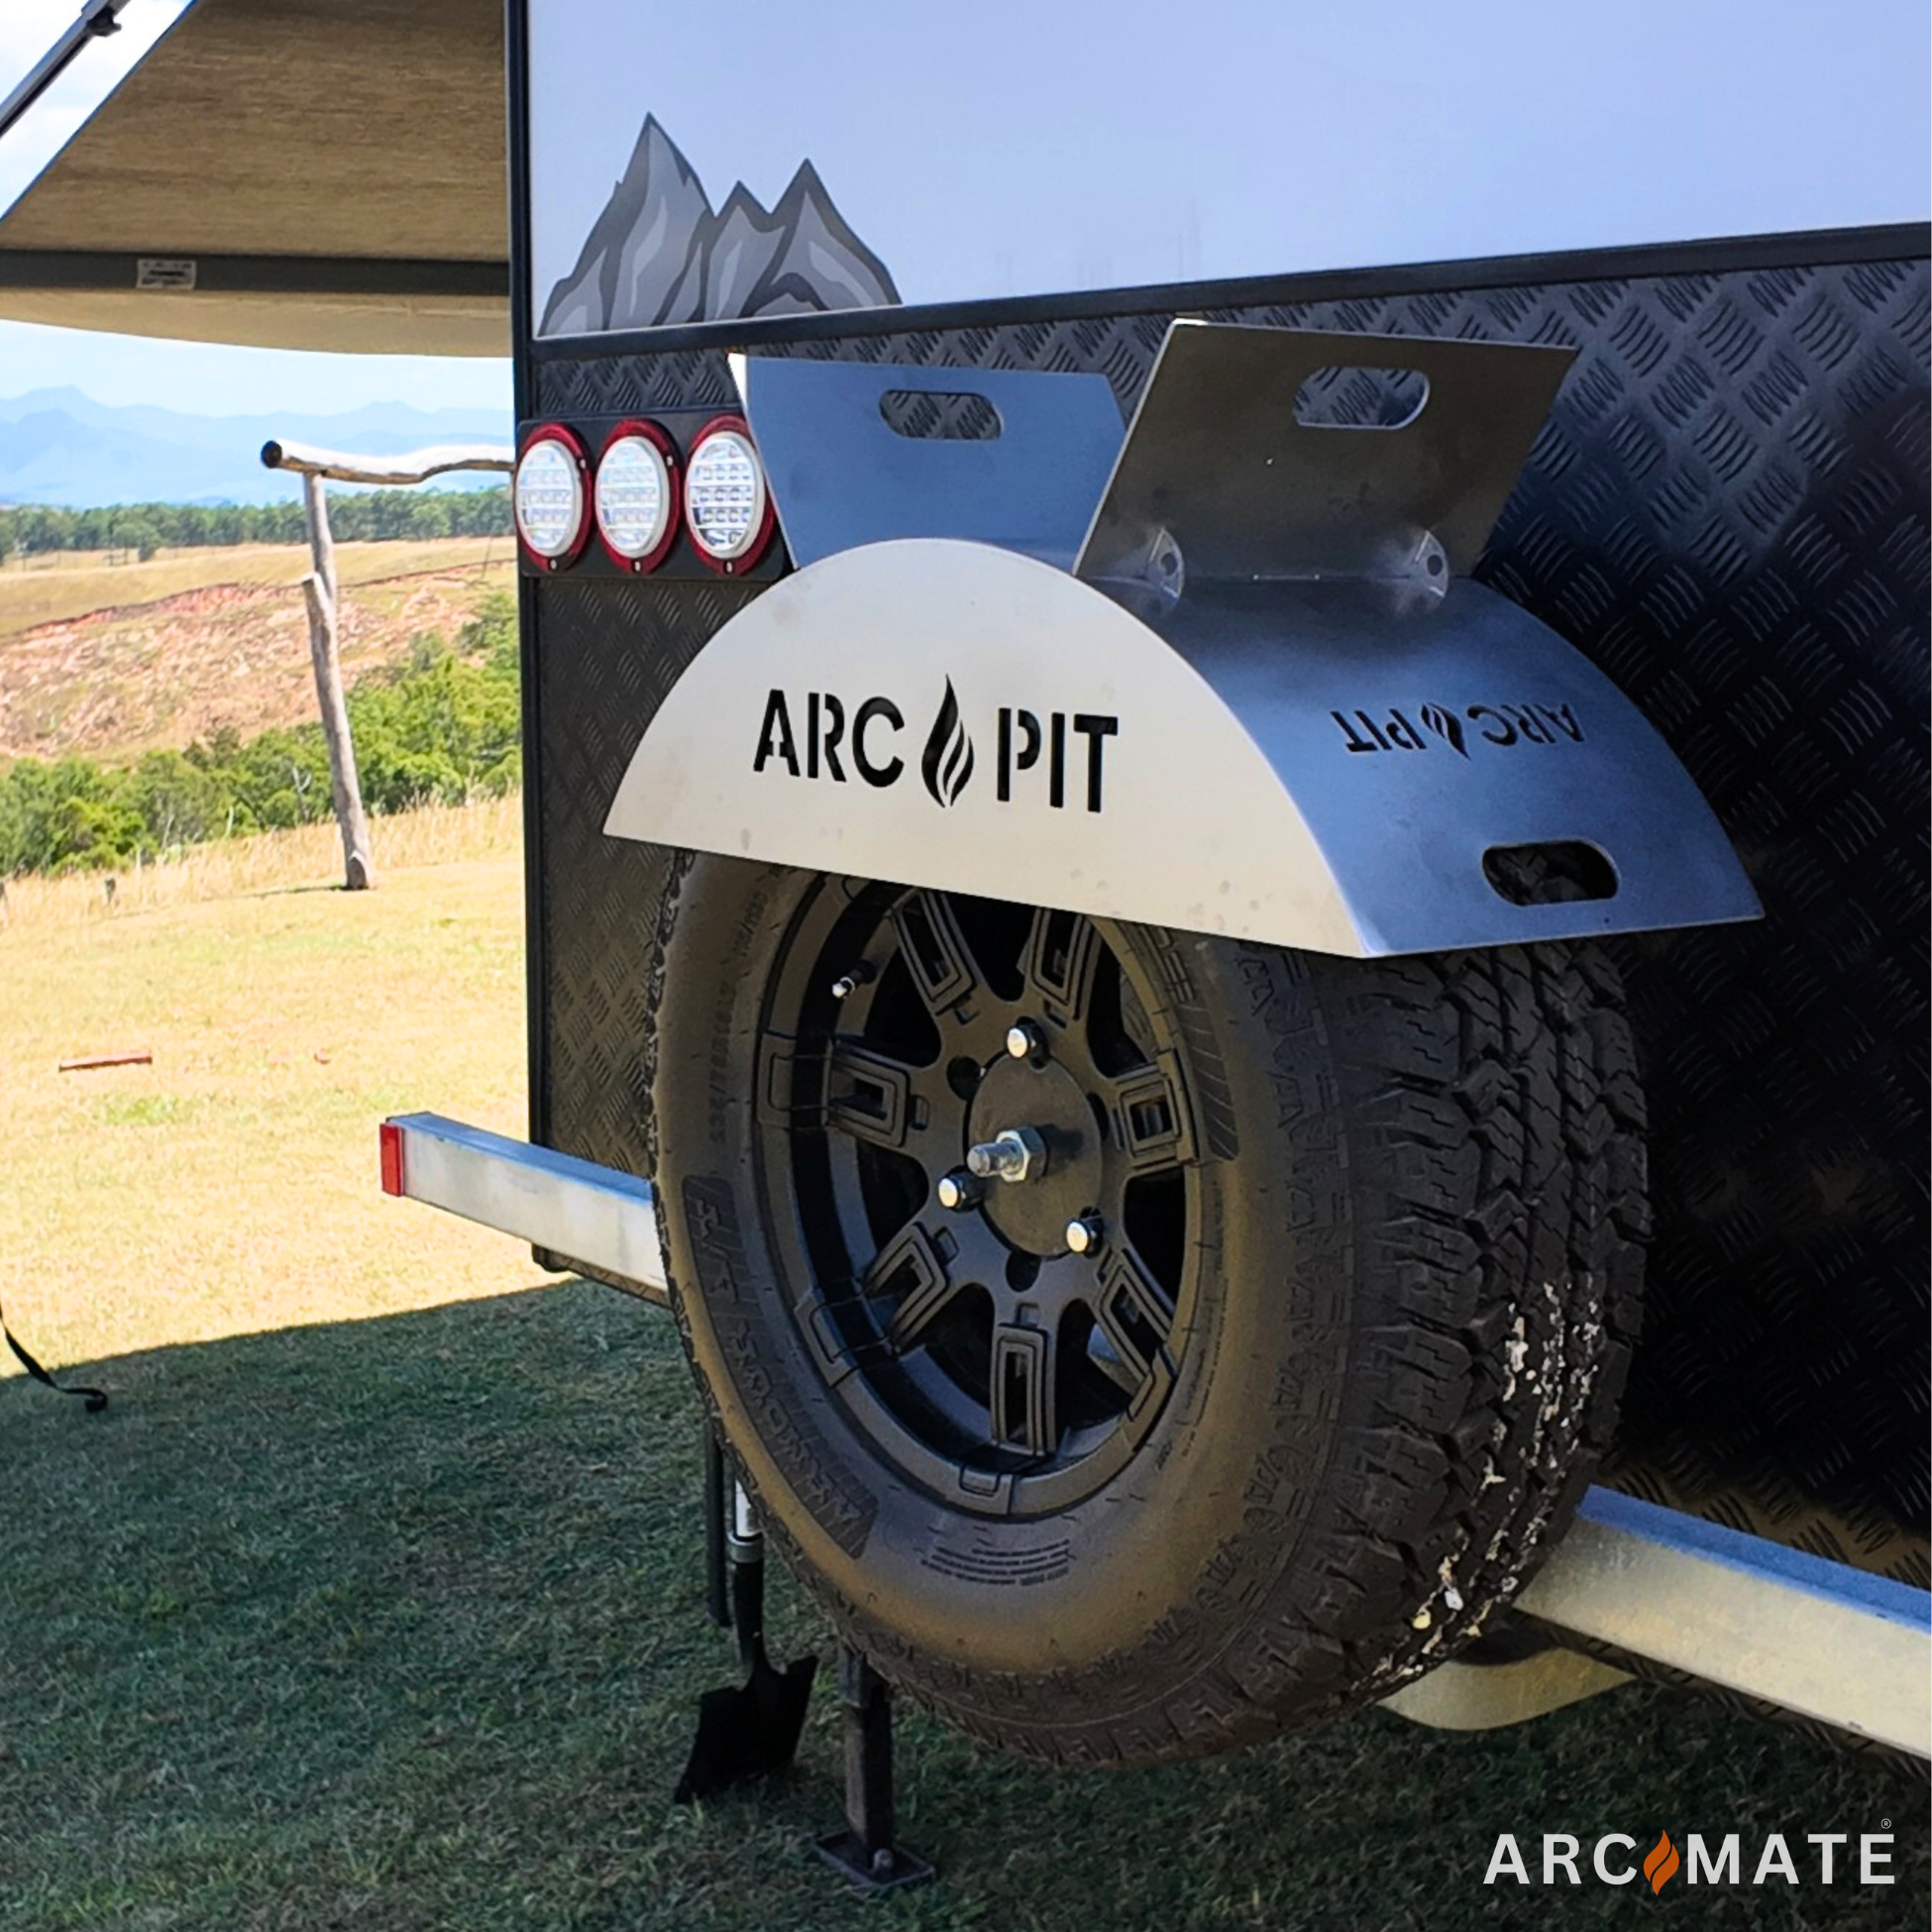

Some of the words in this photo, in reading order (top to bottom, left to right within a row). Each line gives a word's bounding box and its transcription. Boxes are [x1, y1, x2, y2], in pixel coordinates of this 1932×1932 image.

[1330, 707, 1428, 753] PIT
[1466, 703, 1584, 746] ARC
[753, 688, 905, 789] ARC
[996, 706, 1120, 813] PIT
